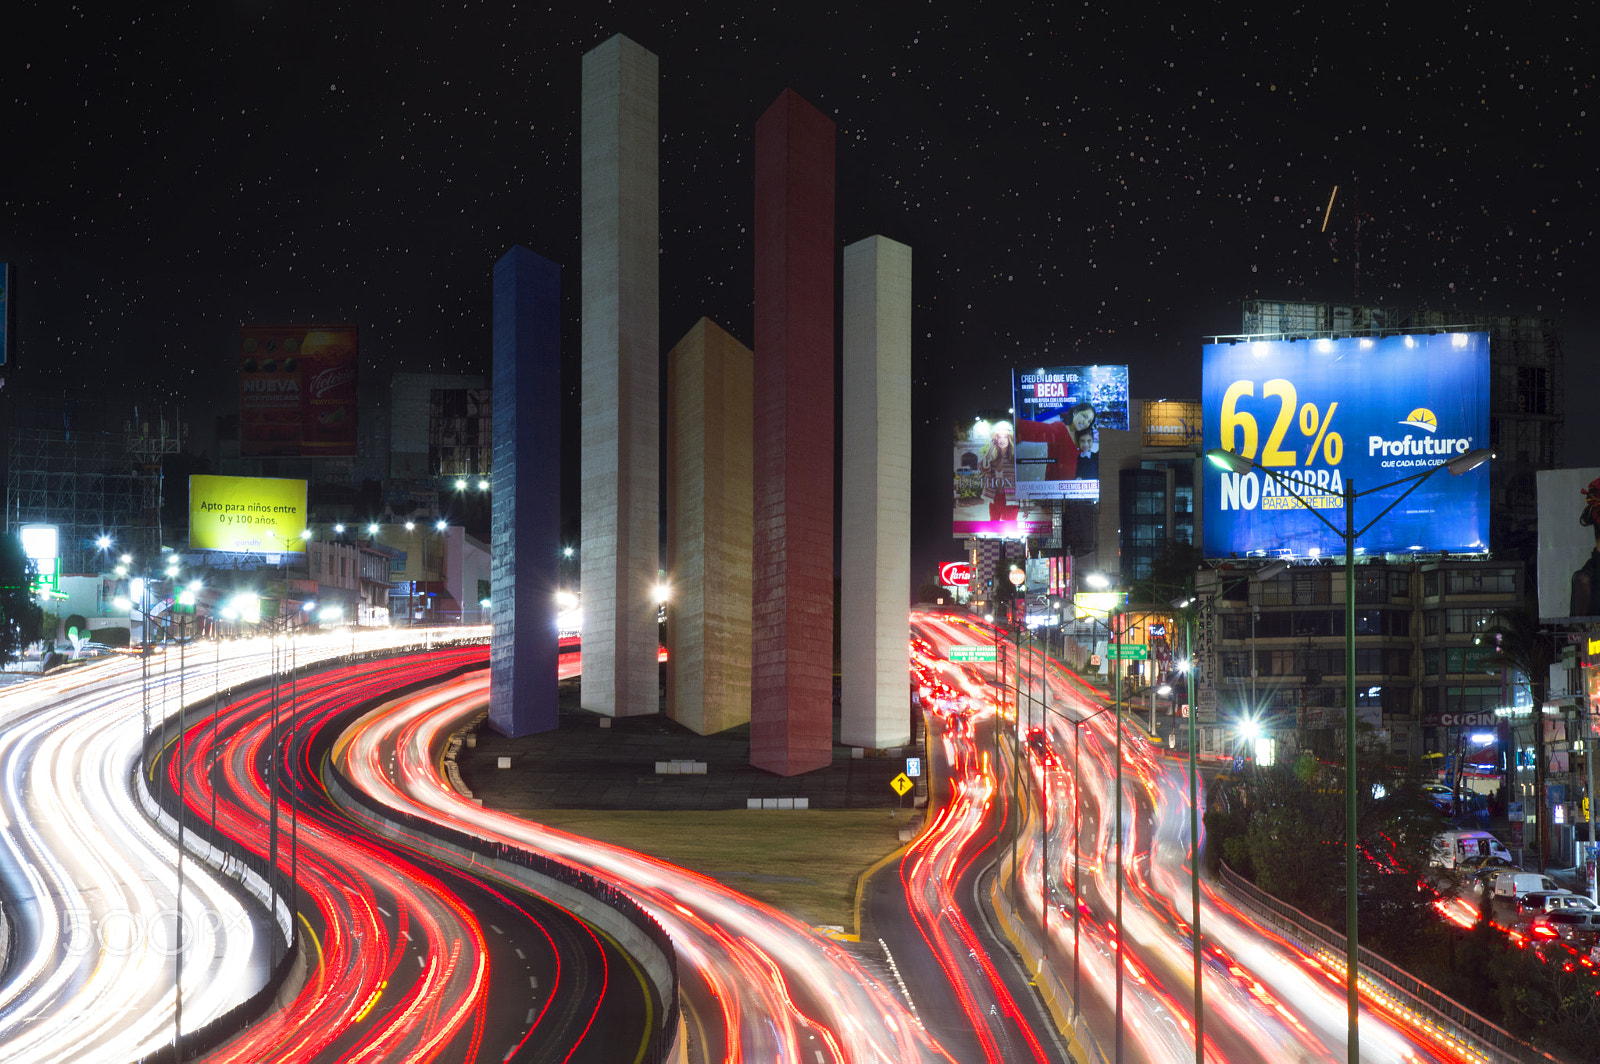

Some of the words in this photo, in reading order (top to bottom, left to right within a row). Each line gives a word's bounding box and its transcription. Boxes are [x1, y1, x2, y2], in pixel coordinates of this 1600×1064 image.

[1021, 375, 1036, 383] CREO
[1053, 374, 1064, 382] QUE
[243, 379, 299, 392] NUEVA
[1038, 383, 1064, 397] BECA
[1220, 378, 1343, 467] 62%
[1369, 435, 1470, 456] Profuturo
[1415, 458, 1426, 466] DÍA
[958, 478, 1013, 489] FASHION
[1220, 471, 1259, 510] NO
[1262, 469, 1344, 496] AHORRA
[200, 501, 222, 512] Apto
[225, 504, 245, 512] para
[248, 503, 271, 512] niños
[274, 505, 296, 513] entre
[1262, 497, 1288, 509] PARA
[1290, 496, 1304, 509] SU
[1306, 496, 1342, 508] RETIRO
[220, 514, 225, 522] 0
[228, 516, 233, 525] y
[236, 515, 252, 524] 100
[255, 516, 278, 524] años.
